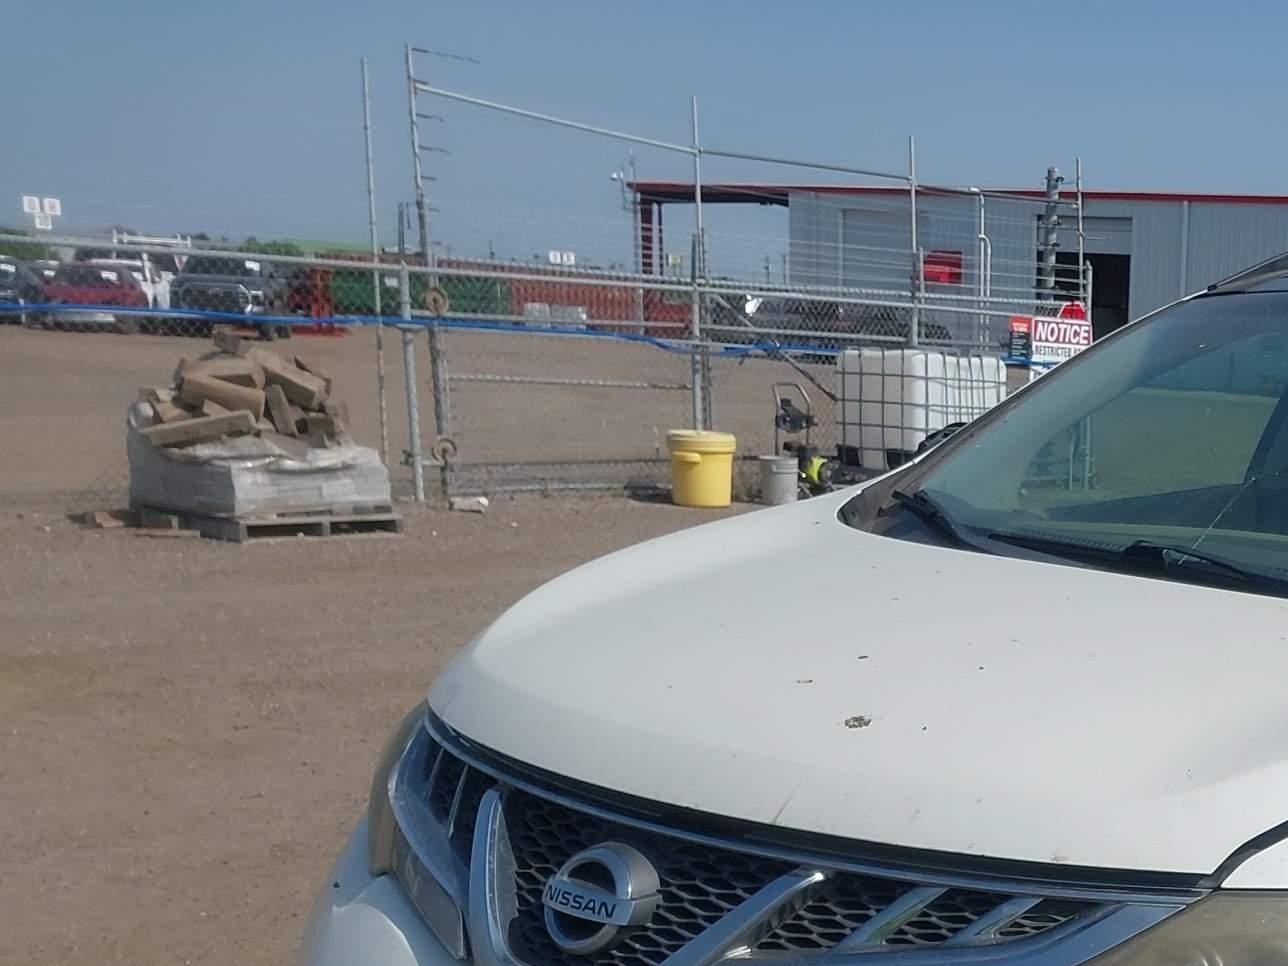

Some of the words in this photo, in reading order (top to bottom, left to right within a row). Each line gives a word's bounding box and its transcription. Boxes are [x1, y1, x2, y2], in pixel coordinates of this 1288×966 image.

[1035, 322, 1089, 344] NOTICE
[1035, 344, 1072, 357] RESTRICTED
[545, 884, 616, 918] NISSAN
